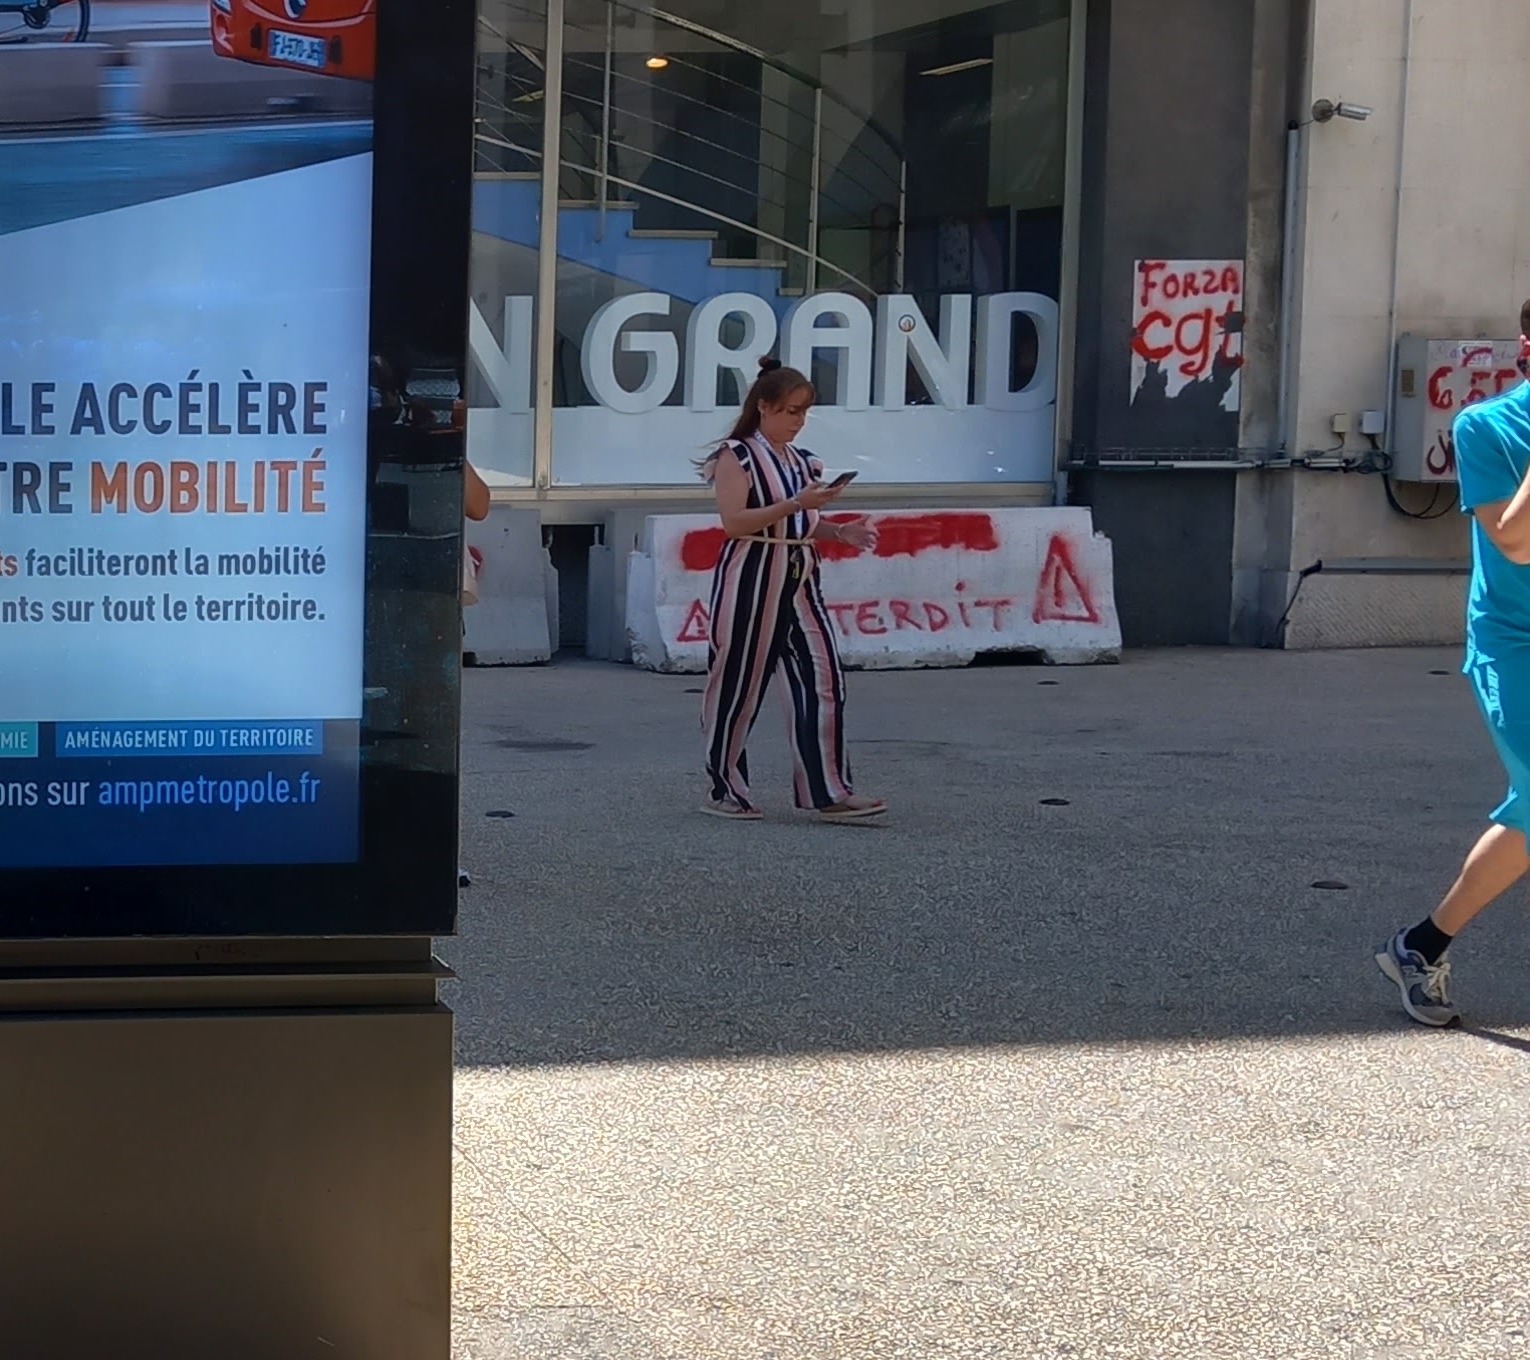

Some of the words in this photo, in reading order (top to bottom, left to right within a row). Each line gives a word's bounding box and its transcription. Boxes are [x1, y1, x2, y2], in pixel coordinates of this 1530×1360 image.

[580, 291, 1059, 415] GRAND
[70, 369, 328, 436] ACCÉLÈRE
[90, 447, 326, 515] MOBILITÉ
[25, 547, 177, 577] faciliteront
[184, 546, 210, 576] la
[218, 545, 326, 576] mobilité
[51, 602, 95, 623] sur
[102, 595, 156, 622] tout
[163, 593, 188, 622] le
[195, 592, 326, 622] territoire.
[64, 727, 188, 749] AMÉNAGEMENT
[193, 729, 215, 747] DU
[220, 728, 314, 747] TERRITOIRE
[47, 782, 90, 805] sur
[98, 771, 321, 813] ampmetropole.fr
